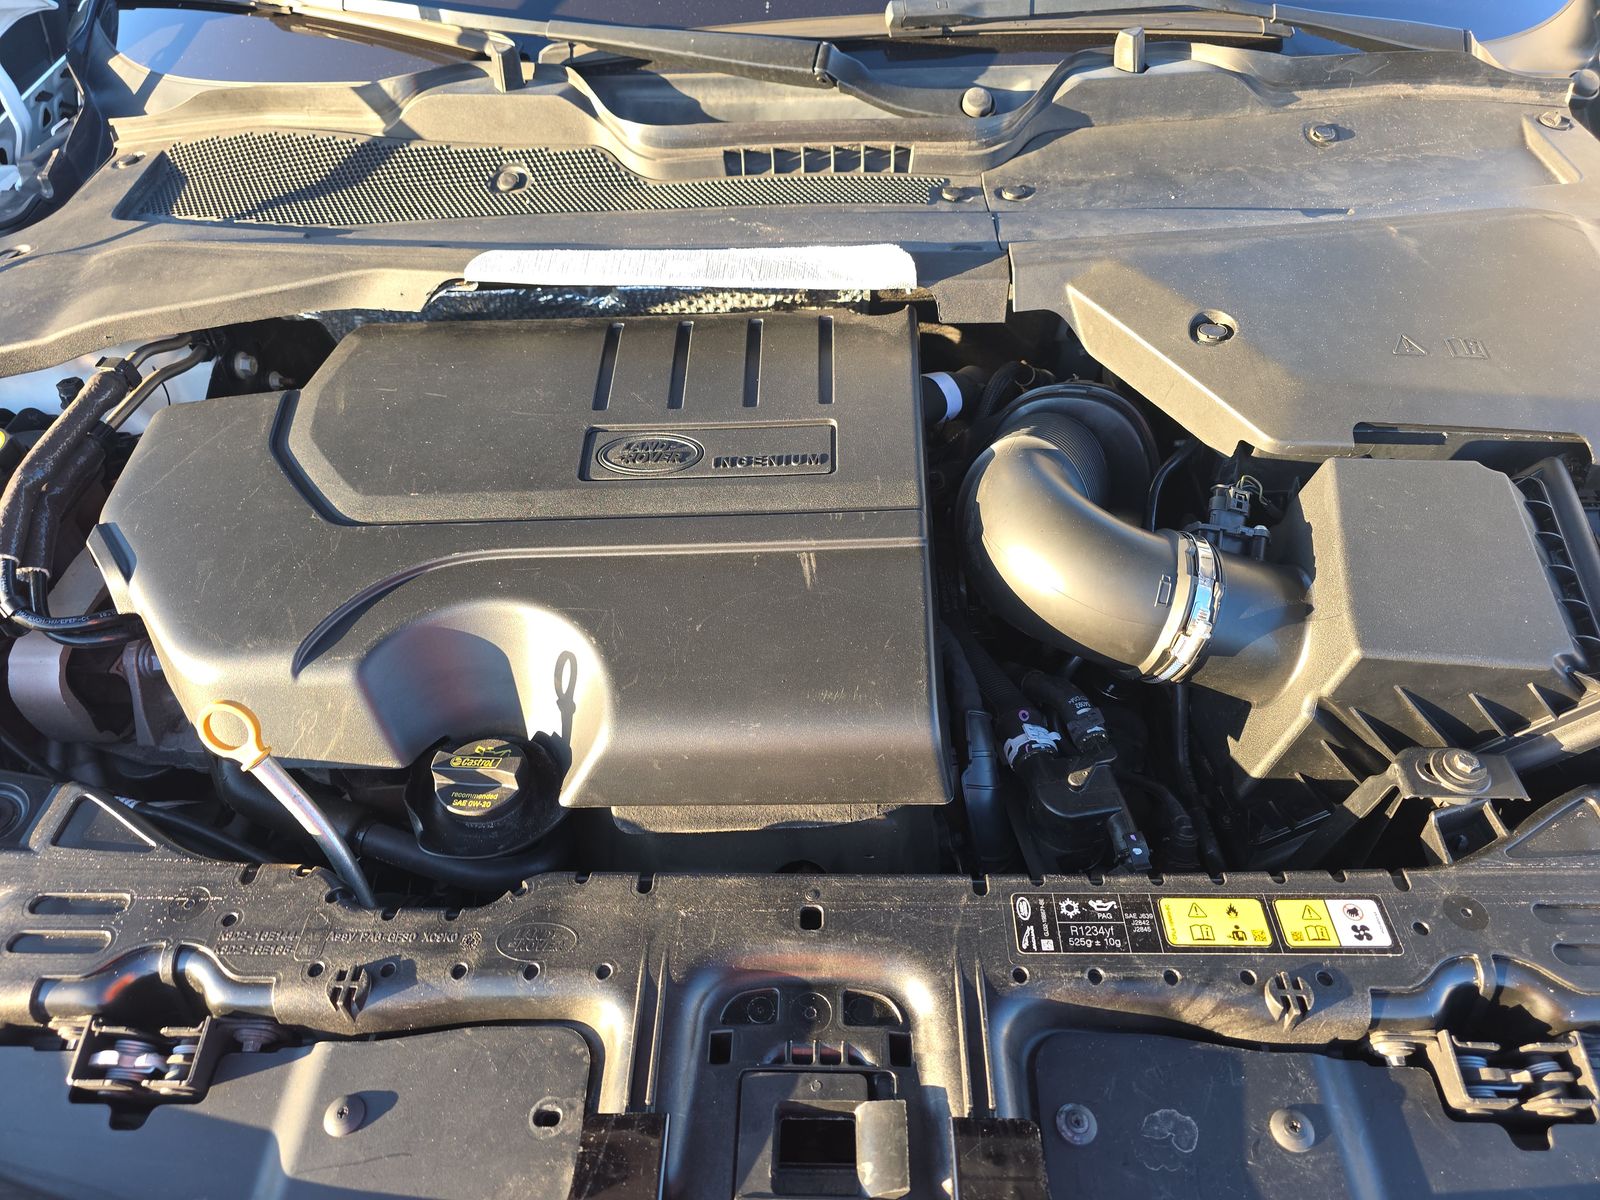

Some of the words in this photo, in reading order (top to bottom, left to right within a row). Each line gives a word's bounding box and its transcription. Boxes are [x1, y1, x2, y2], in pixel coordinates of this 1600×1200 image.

[624, 440, 671, 452] LAND
[624, 451, 681, 464] ROVER
[712, 454, 828, 468] INGENIUM
[461, 758, 496, 768] Castrol
[451, 791, 499, 800] recommended
[468, 800, 491, 809] 0W-20
[1097, 912, 1113, 920] PAG
[1070, 925, 1115, 938] R1234yf
[1069, 937, 1092, 948] 525g
[1104, 938, 1122, 948] 10g
